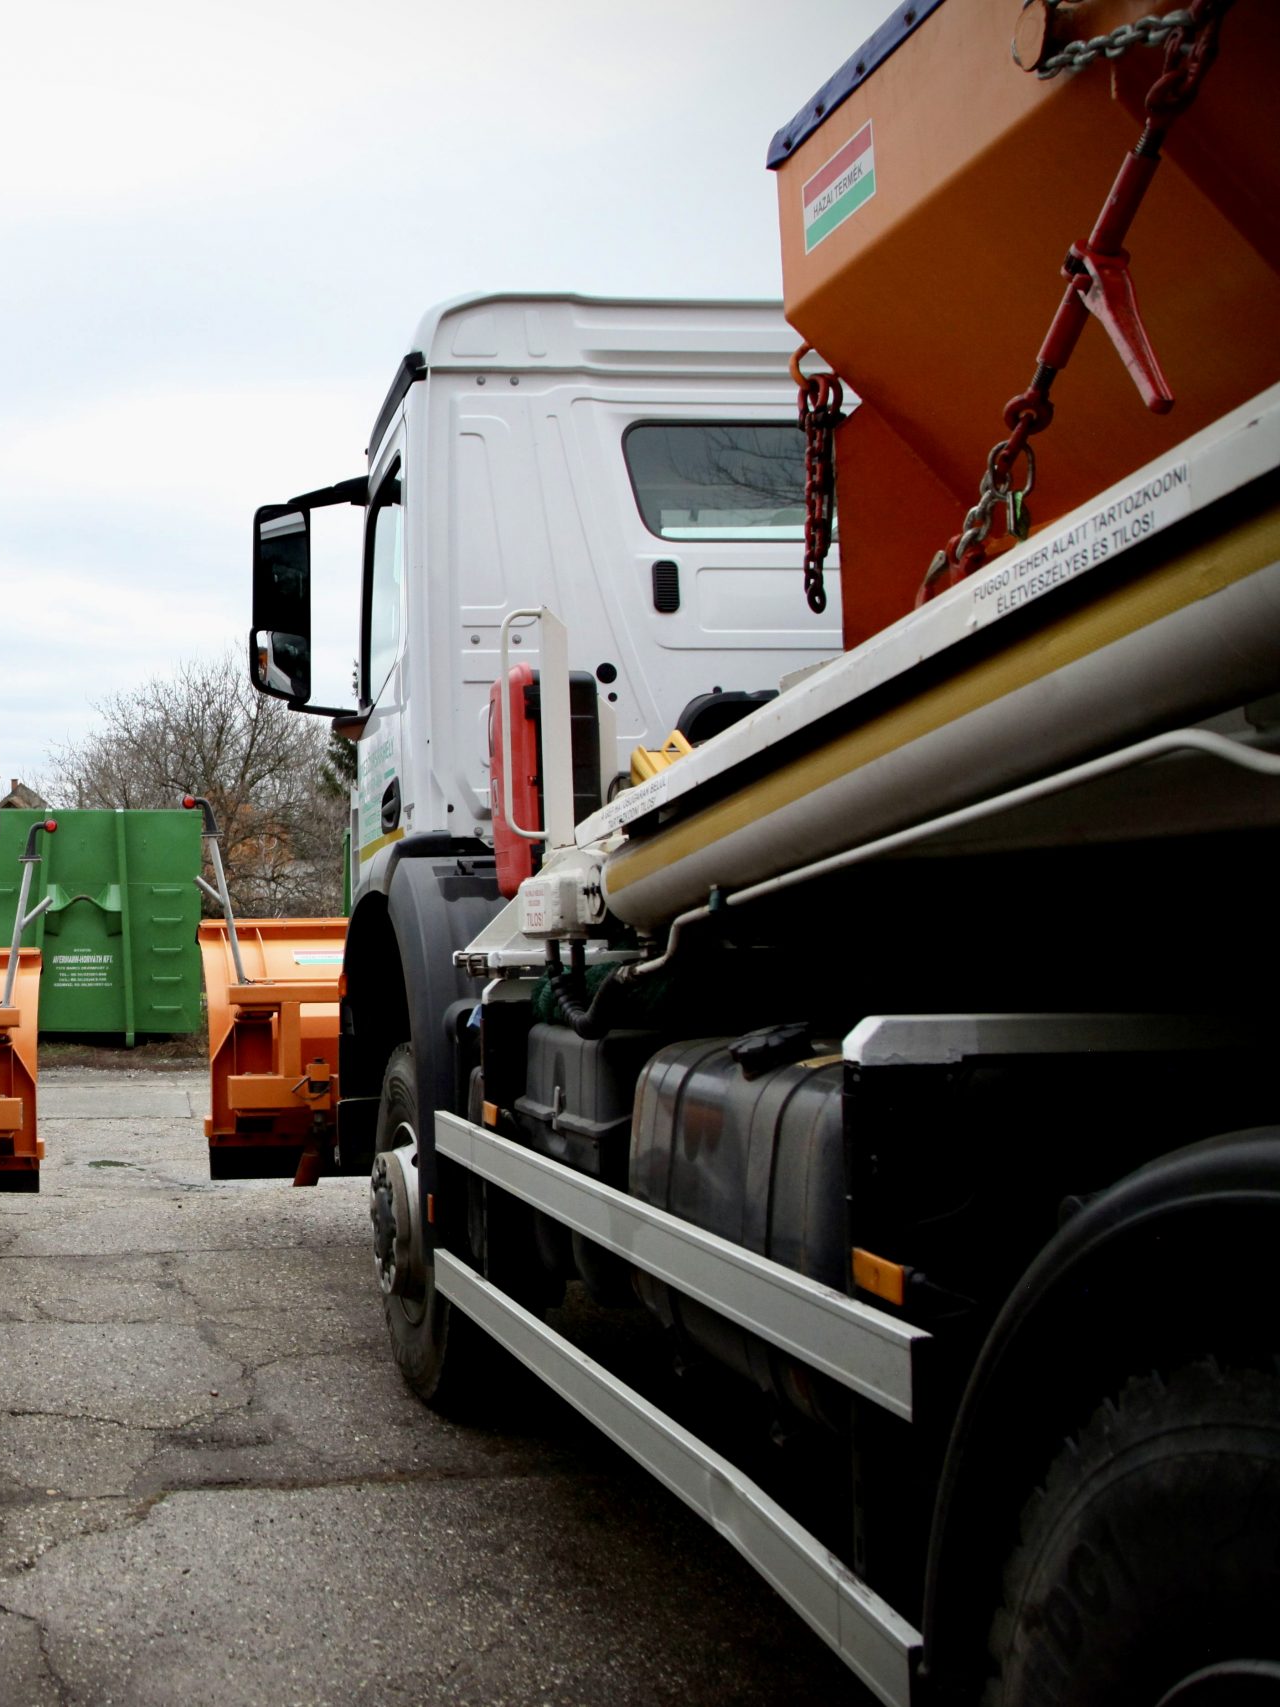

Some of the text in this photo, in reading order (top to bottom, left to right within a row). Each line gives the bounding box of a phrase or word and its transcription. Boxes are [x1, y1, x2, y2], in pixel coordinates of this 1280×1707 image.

[813, 193, 833, 218] HAZAI
[1012, 546, 1049, 580] TEHER
[1051, 521, 1089, 556] ALATT
[1091, 536, 1109, 560] ÉS
[1111, 511, 1156, 555] TILOS!
